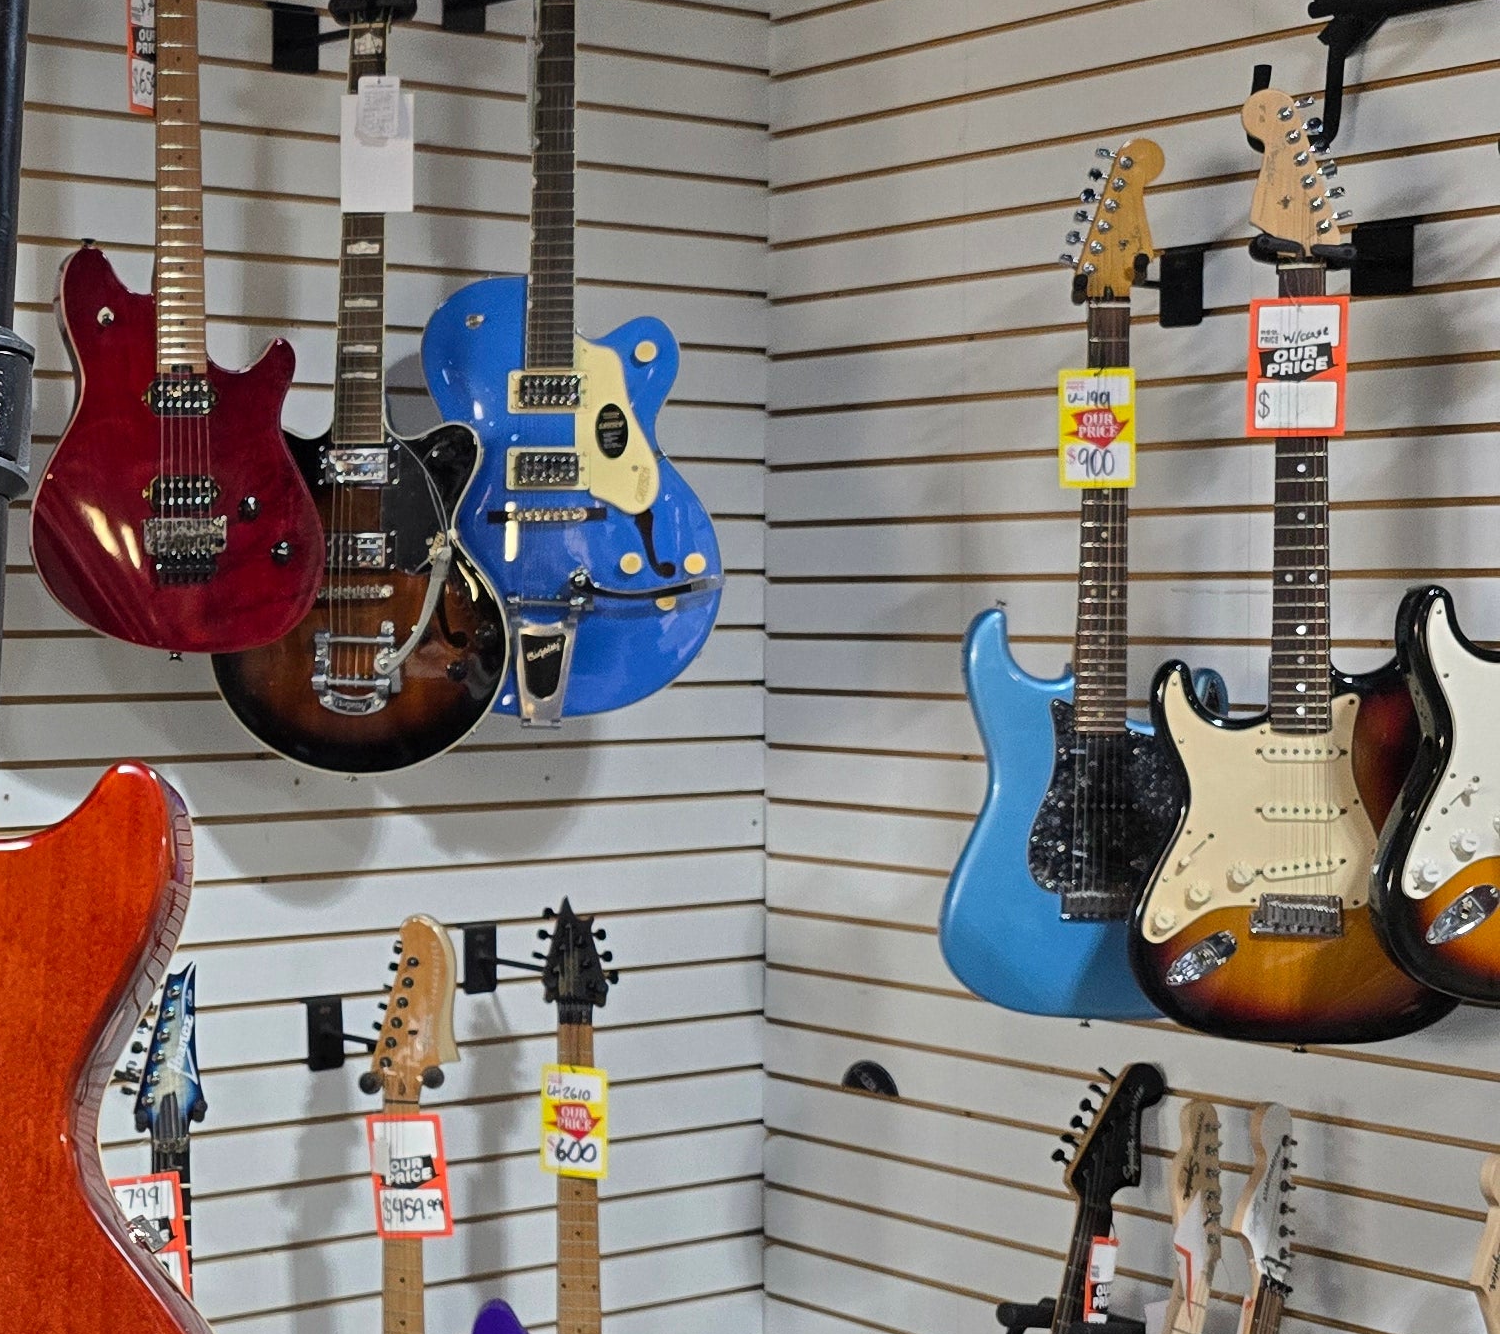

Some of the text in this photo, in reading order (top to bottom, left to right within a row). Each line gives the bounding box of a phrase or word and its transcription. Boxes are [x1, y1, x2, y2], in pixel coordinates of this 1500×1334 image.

[1273, 346, 1318, 364] OUR
[1266, 355, 1329, 377] PRICE
[1082, 413, 1114, 427] OUR
[1077, 425, 1120, 439] PRICE
[1066, 447, 1116, 479] $900
[561, 1105, 588, 1119] OUR
[556, 1116, 593, 1132] PRICE
[389, 1157, 424, 1173] OUR
[385, 1166, 434, 1186] PRICE
